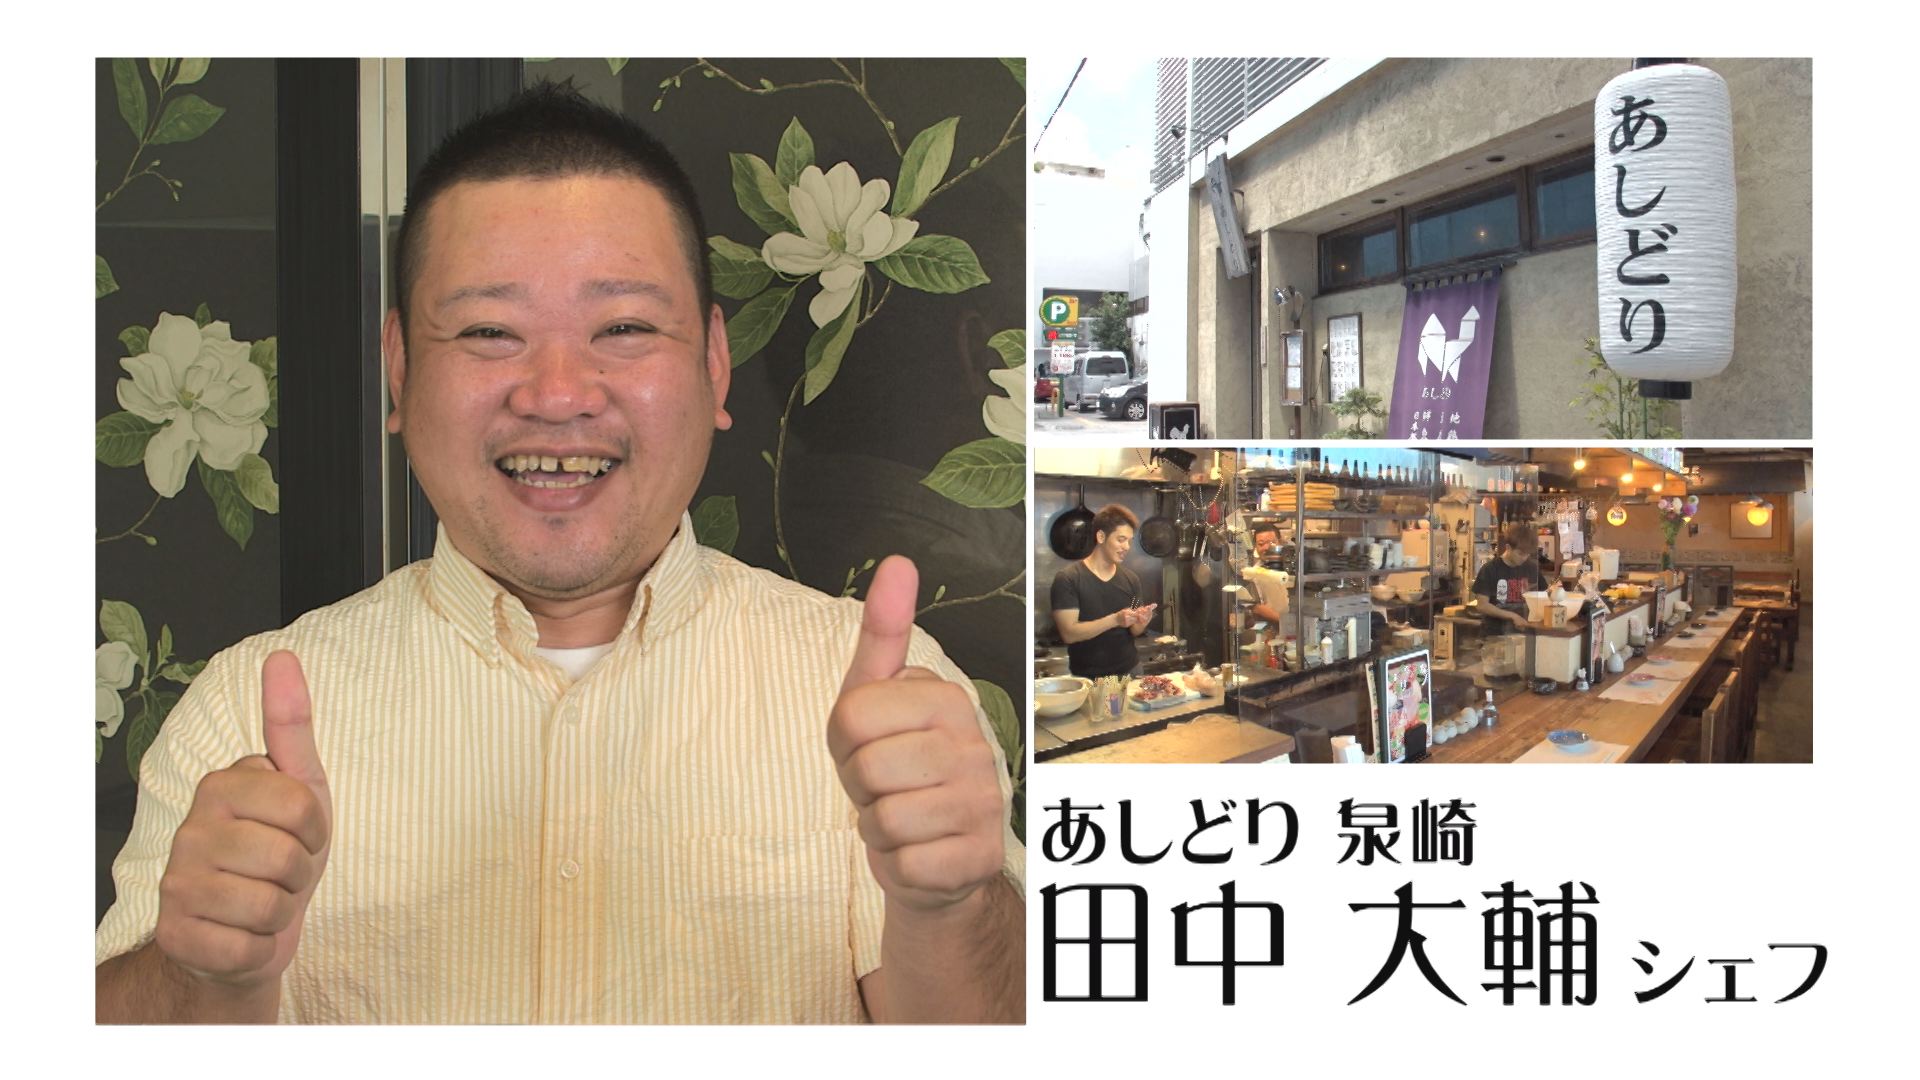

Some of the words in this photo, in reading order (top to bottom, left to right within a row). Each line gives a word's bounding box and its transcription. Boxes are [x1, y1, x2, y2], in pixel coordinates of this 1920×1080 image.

[1609, 95, 1678, 354] あしどり
[1050, 301, 1067, 321] P
